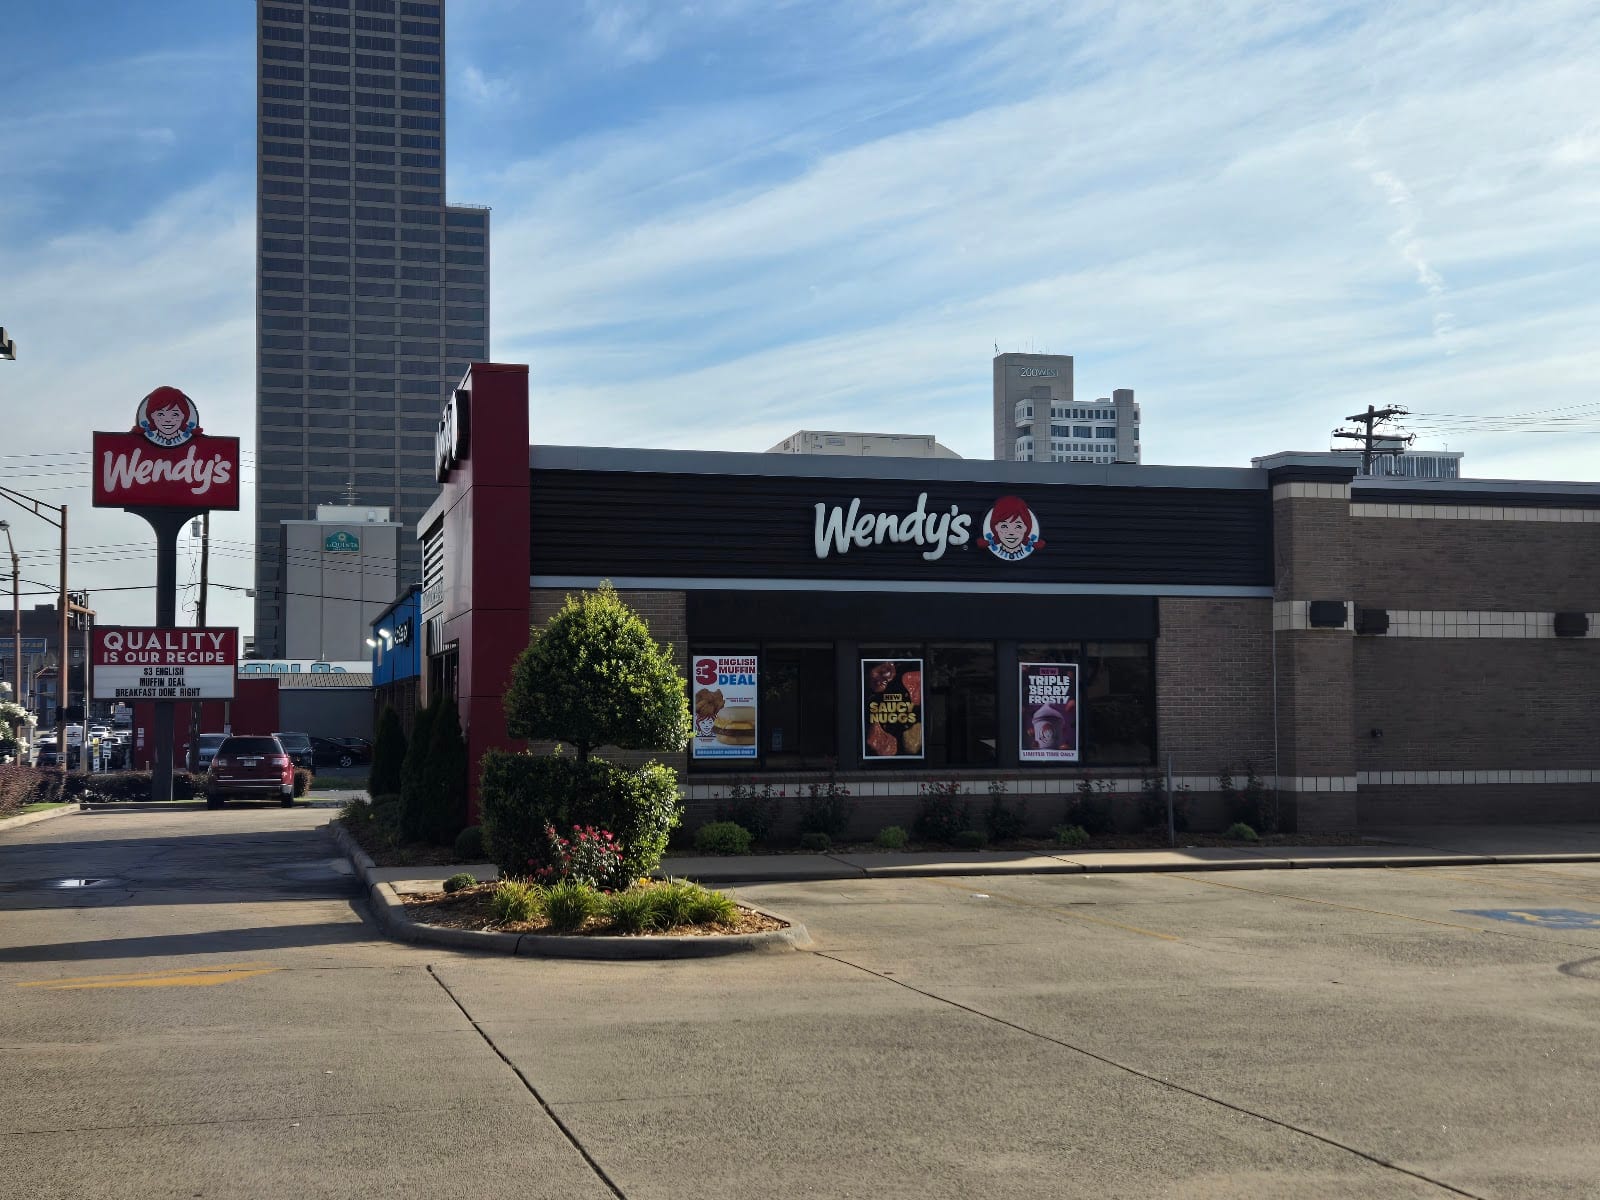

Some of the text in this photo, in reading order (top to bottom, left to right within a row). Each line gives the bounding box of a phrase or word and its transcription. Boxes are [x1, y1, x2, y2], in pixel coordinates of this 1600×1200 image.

[103, 444, 232, 495] Wendy's
[814, 492, 972, 561] Wendy's
[103, 631, 225, 651] QUALITY
[103, 651, 225, 663] IS OUR RECIPE
[718, 658, 756, 666] ENGLISH
[155, 667, 184, 676] ENGLISH
[695, 658, 718, 685] $3
[718, 666, 756, 674] MUFFIN
[139, 677, 186, 687] MUFFIN DEAL
[718, 674, 756, 685] DEAL
[1028, 675, 1070, 686] TRIPLE
[115, 688, 201, 698] BREAKFAST DONE RIGHT
[1028, 685, 1070, 696] BERRY
[1028, 695, 1070, 704] FROSTY
[869, 702, 914, 713] SAUCY
[869, 713, 917, 724] NUGGS
